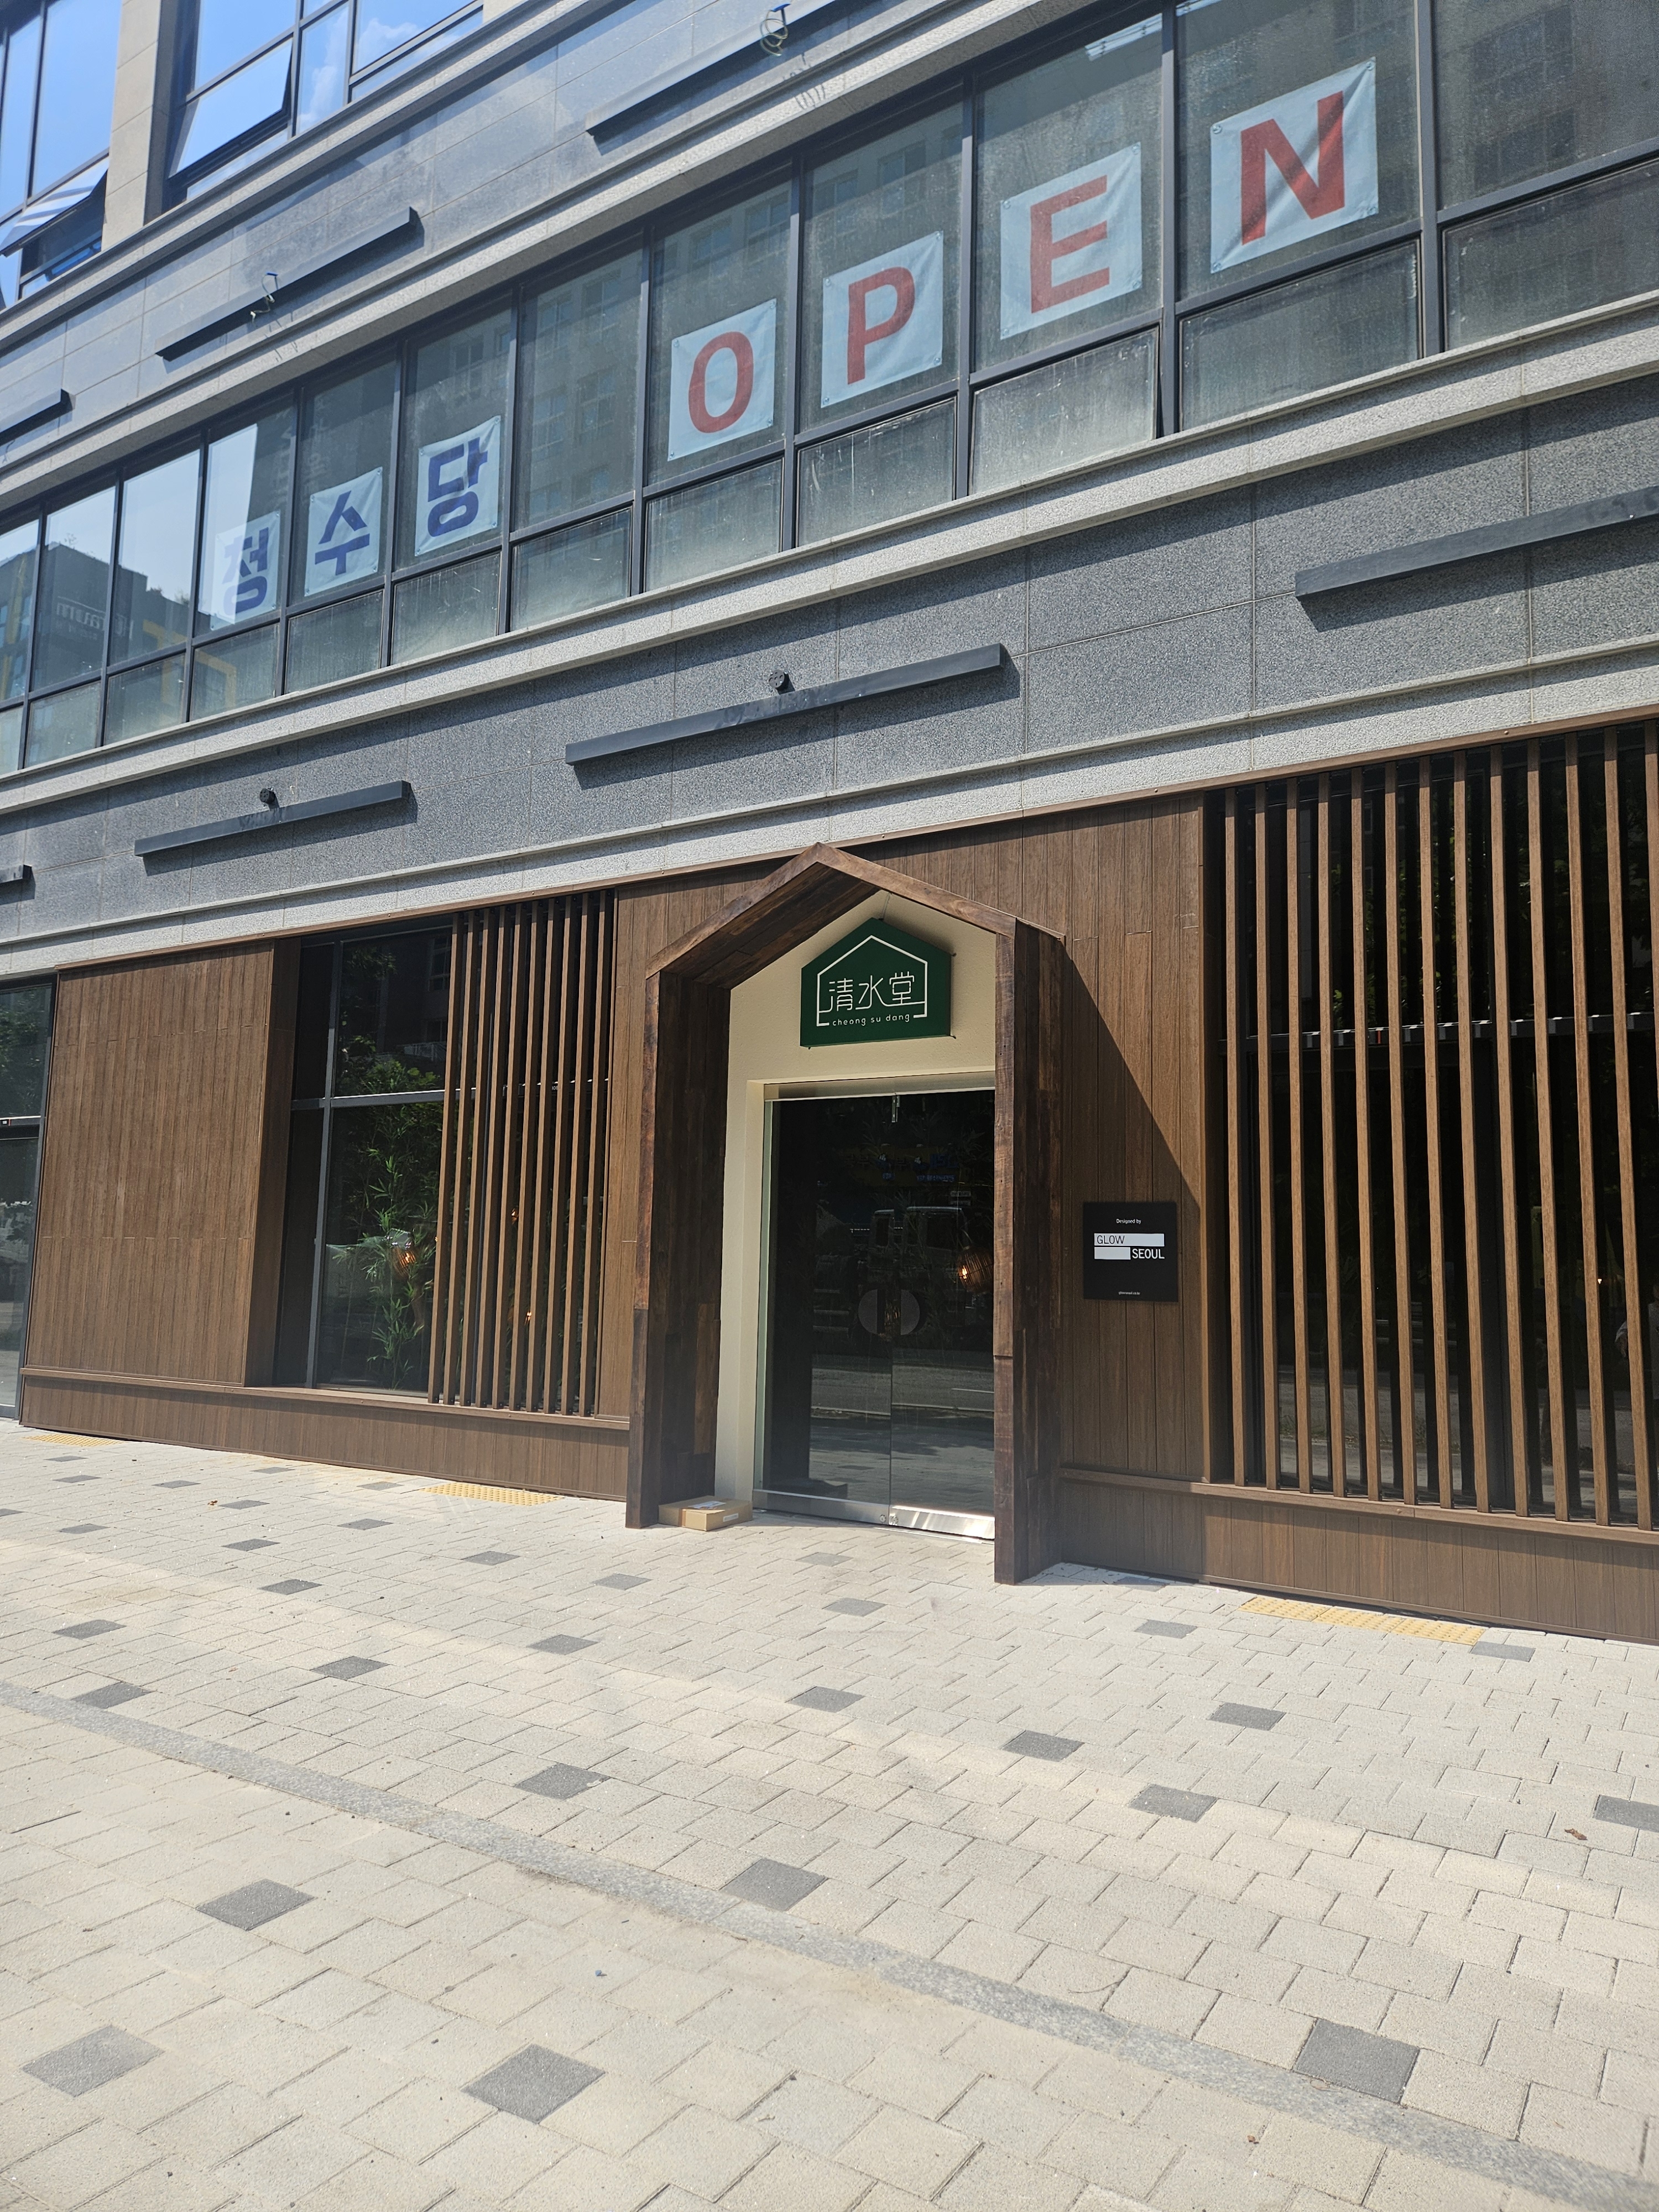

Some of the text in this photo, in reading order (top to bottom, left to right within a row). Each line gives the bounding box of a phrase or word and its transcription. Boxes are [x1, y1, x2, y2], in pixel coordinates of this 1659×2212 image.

[687, 91, 1344, 433] OPEN
[222, 436, 488, 615] 청수당
[828, 971, 915, 1011] 清水堂
[832, 1018, 866, 1026] cheong
[885, 1014, 910, 1022] dang
[1097, 1235, 1125, 1244] GLOW
[1132, 1248, 1165, 1259] SEOUL
